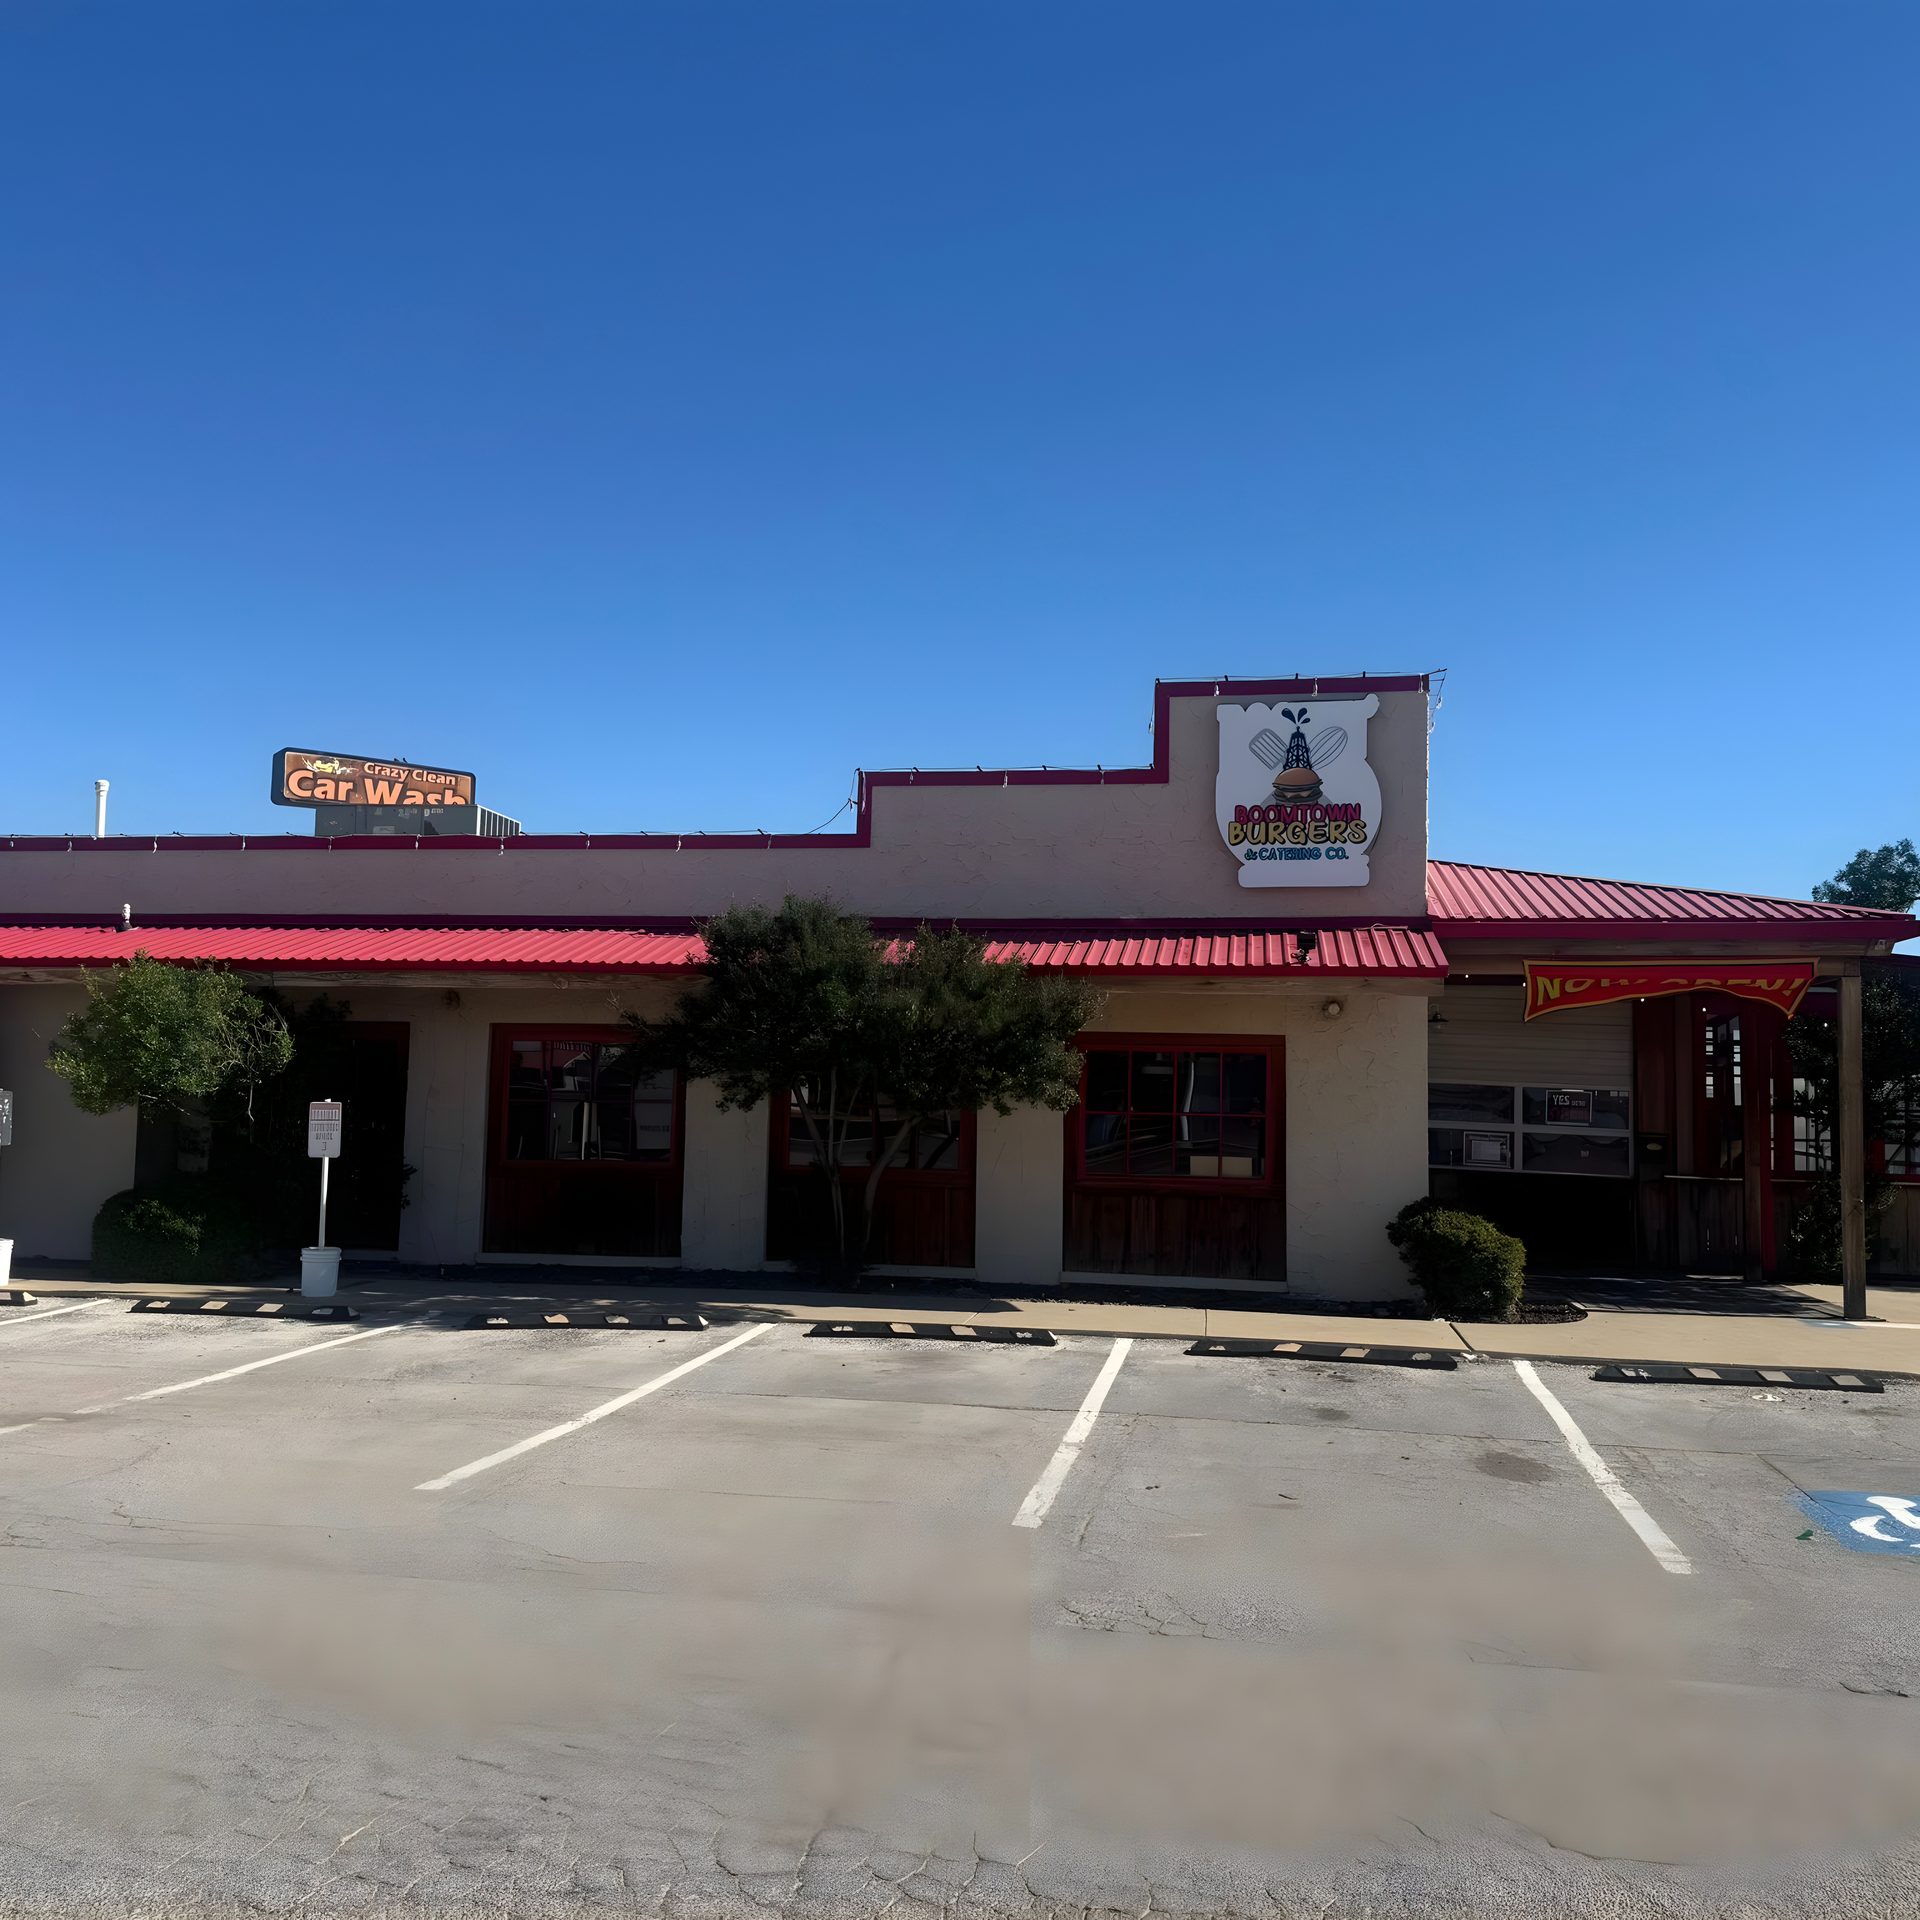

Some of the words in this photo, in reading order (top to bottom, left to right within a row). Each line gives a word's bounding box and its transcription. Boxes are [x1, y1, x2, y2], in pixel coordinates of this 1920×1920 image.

[364, 762, 410, 782] Crazy
[412, 769, 455, 785] Clean
[288, 769, 353, 802] Car
[1234, 803, 1361, 824] BOOMTOWN
[1228, 819, 1367, 846] BURGERS
[1325, 846, 1349, 861] CO.
[1552, 1094, 1570, 1106] YES
